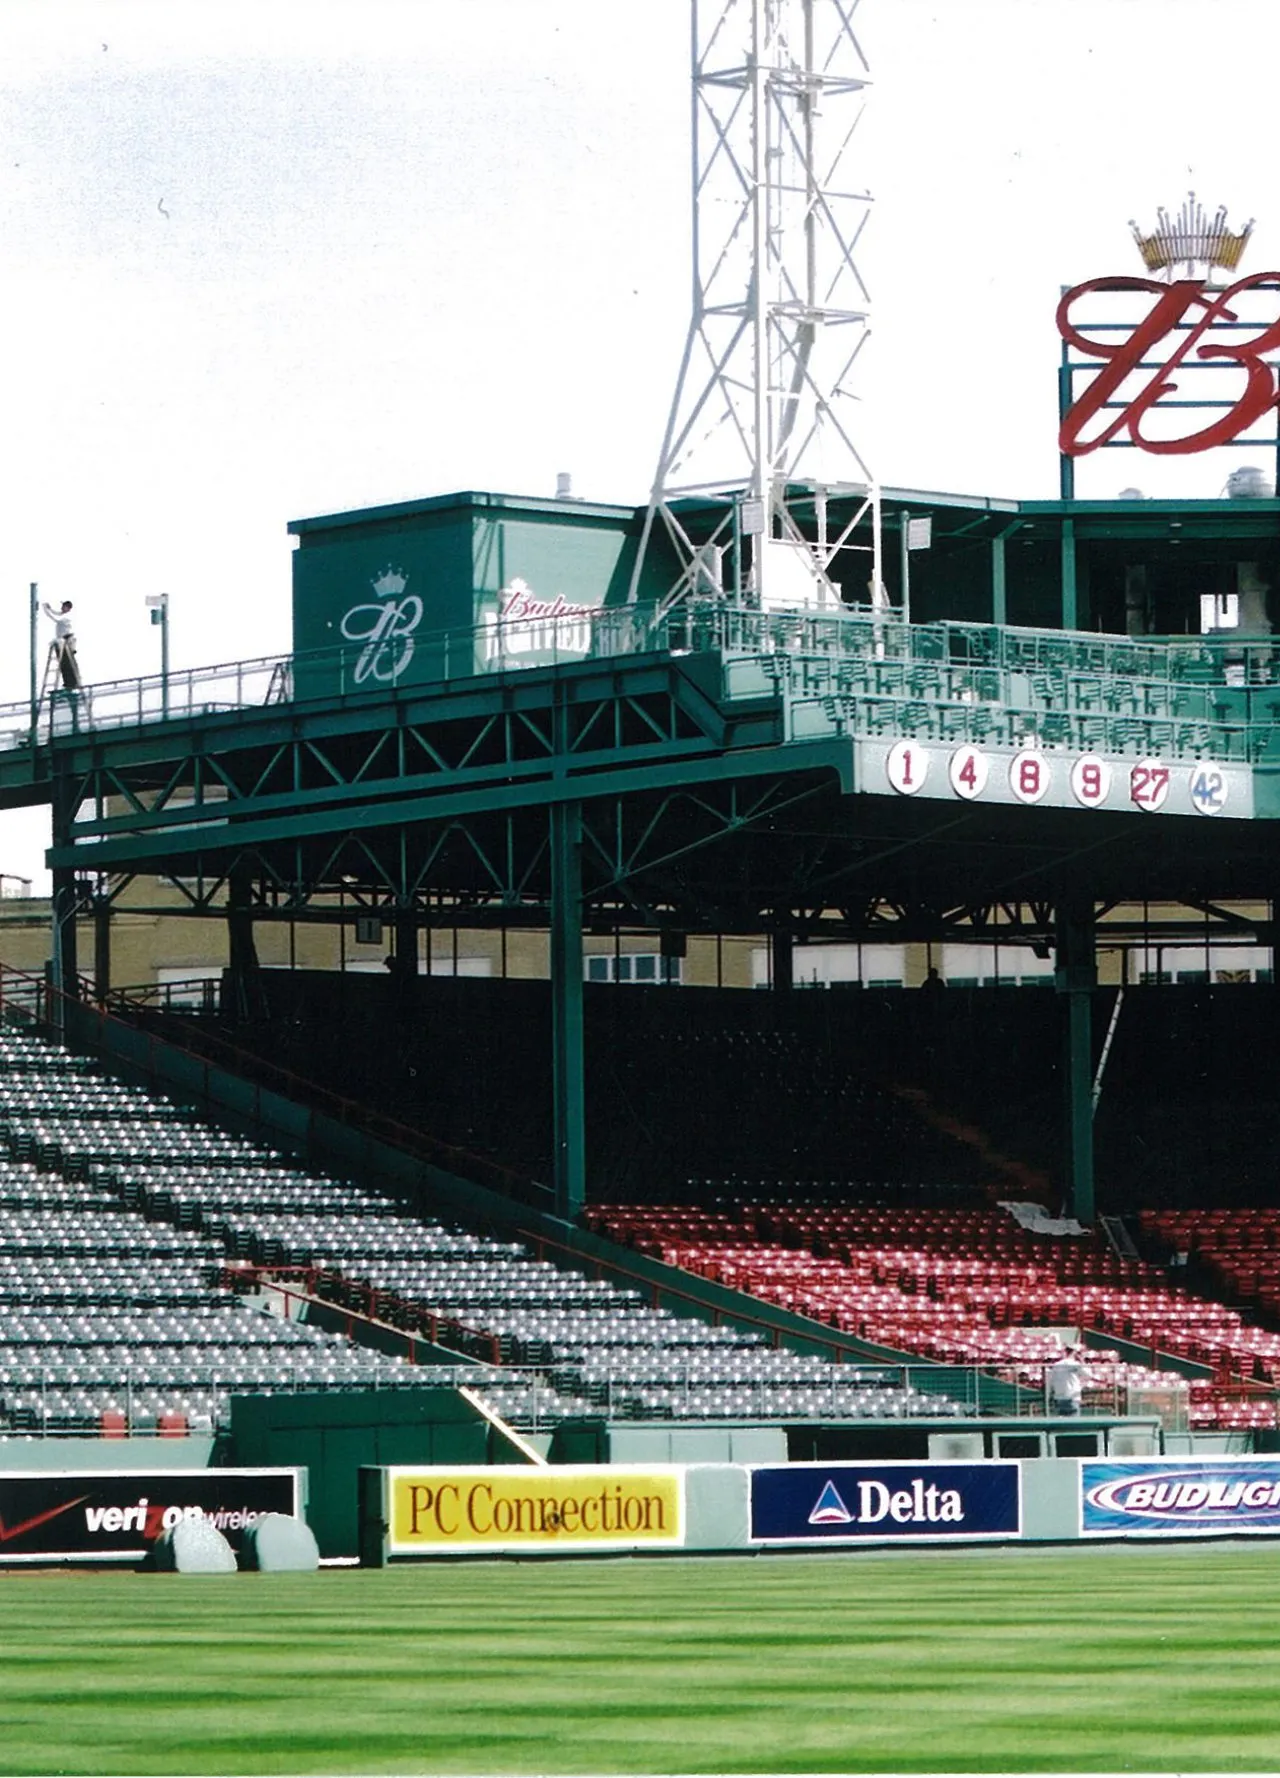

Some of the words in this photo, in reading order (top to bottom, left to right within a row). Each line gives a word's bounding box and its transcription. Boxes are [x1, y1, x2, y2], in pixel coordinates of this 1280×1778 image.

[903, 749, 913, 785] 1
[959, 755, 977, 790] 4
[1020, 759, 1040, 794] 8
[1082, 764, 1101, 798] 9
[1131, 767, 1169, 802] 27
[1193, 772, 1222, 806] 42
[408, 1484, 459, 1535] PC
[466, 1483, 666, 1534] Connection
[855, 1479, 965, 1523] Delta
[1125, 1482, 1207, 1511] BUD
[202, 1506, 280, 1529] wirele
